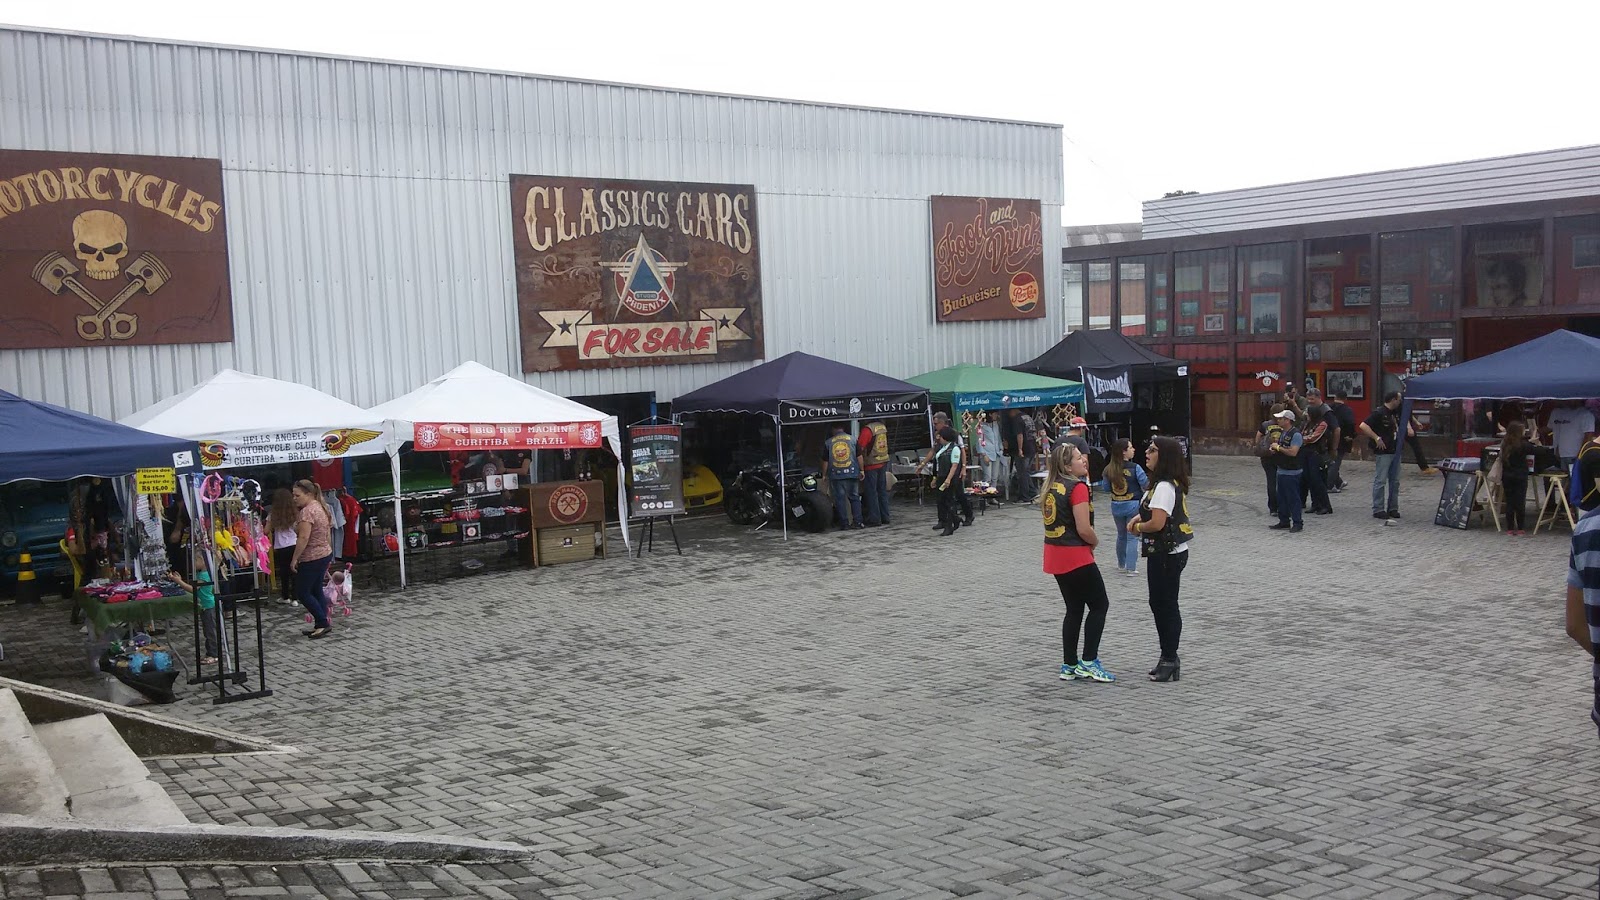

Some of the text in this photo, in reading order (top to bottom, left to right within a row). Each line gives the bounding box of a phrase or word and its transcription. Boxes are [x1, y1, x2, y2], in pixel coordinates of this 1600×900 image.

[989, 199, 1017, 225] and
[523, 186, 752, 254] CLASSICS CARS
[936, 198, 1043, 287] Food Drink
[625, 296, 666, 311] PHOENIX
[942, 286, 1001, 316] Budweiser
[583, 326, 714, 358] FOR SALE
[789, 407, 838, 418] DOCTOR
[875, 402, 919, 413] KUSTOM
[423, 432, 433, 441] 81
[445, 426, 469, 434] THE
[475, 426, 493, 434] BIG
[527, 425, 576, 433] MACHINE
[243, 431, 308, 445] HELLS ANGELS
[455, 438, 509, 446] CURITIBA
[526, 437, 567, 445] BRAZIL
[234, 441, 317, 455] MOTORCYCLE CLUB
[234, 454, 275, 466] CURITIBA
[288, 451, 320, 461] BRAZIL
